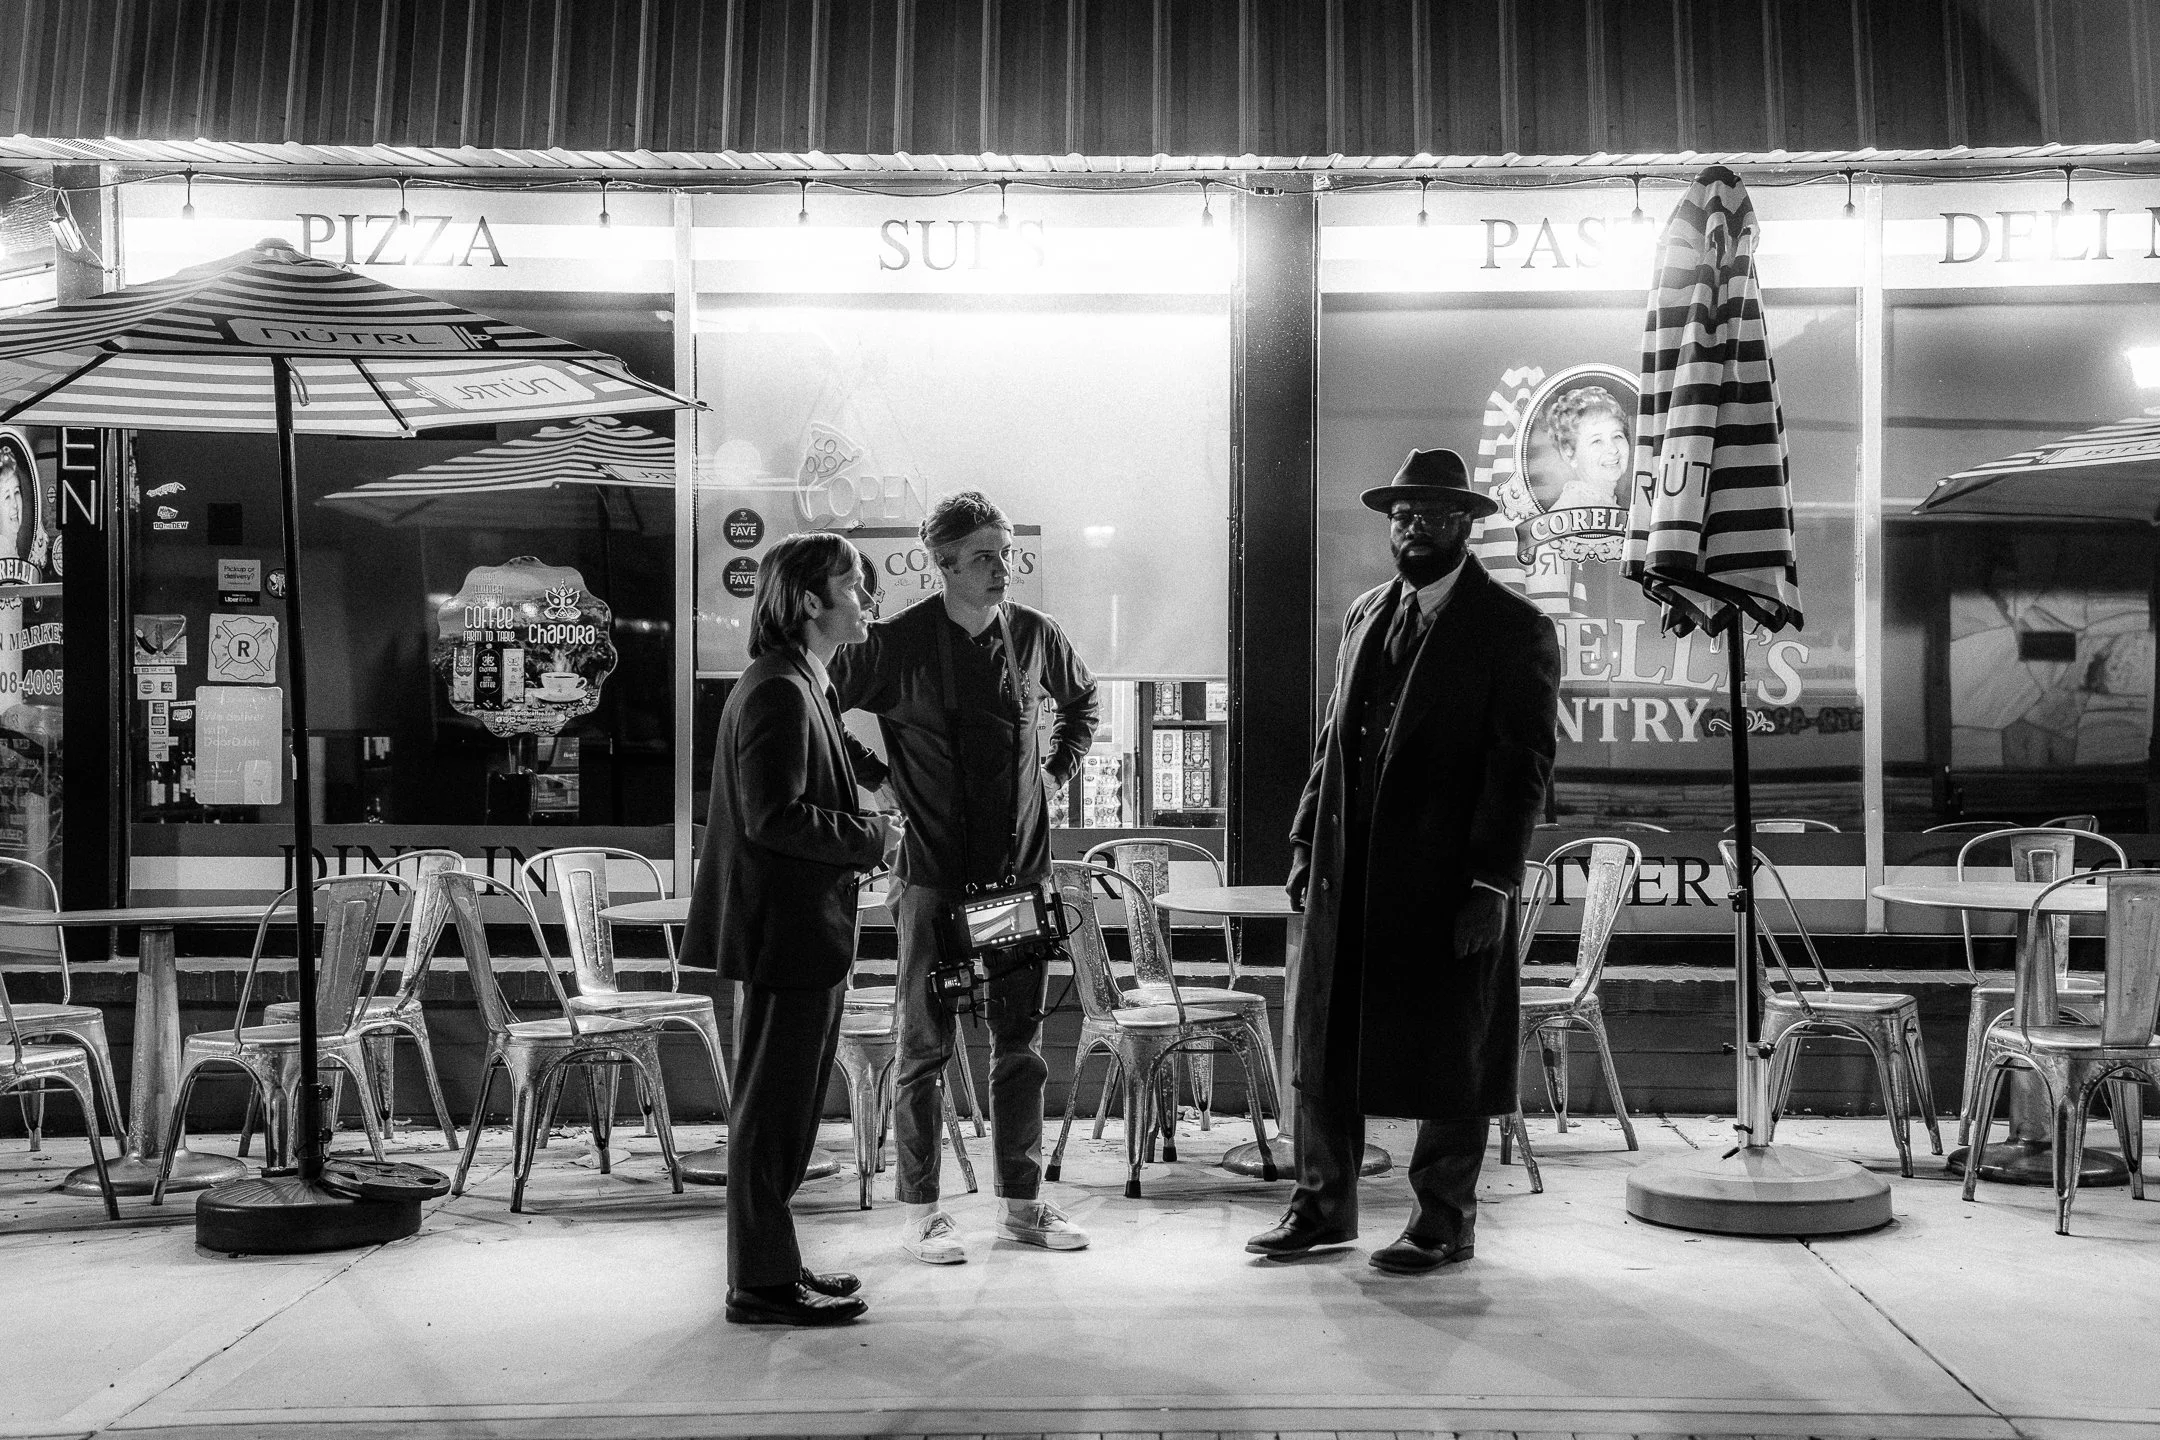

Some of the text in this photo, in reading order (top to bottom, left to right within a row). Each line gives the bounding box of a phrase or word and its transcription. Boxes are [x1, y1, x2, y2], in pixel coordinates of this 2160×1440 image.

[296, 213, 509, 268] PIZZA
[1938, 207, 2116, 264] DELI
[828, 475, 928, 518] OPEN
[730, 527, 757, 536] FAVE
[1530, 508, 1633, 541] COREL
[729, 575, 756, 585] FAVE
[237, 640, 250, 658] R
